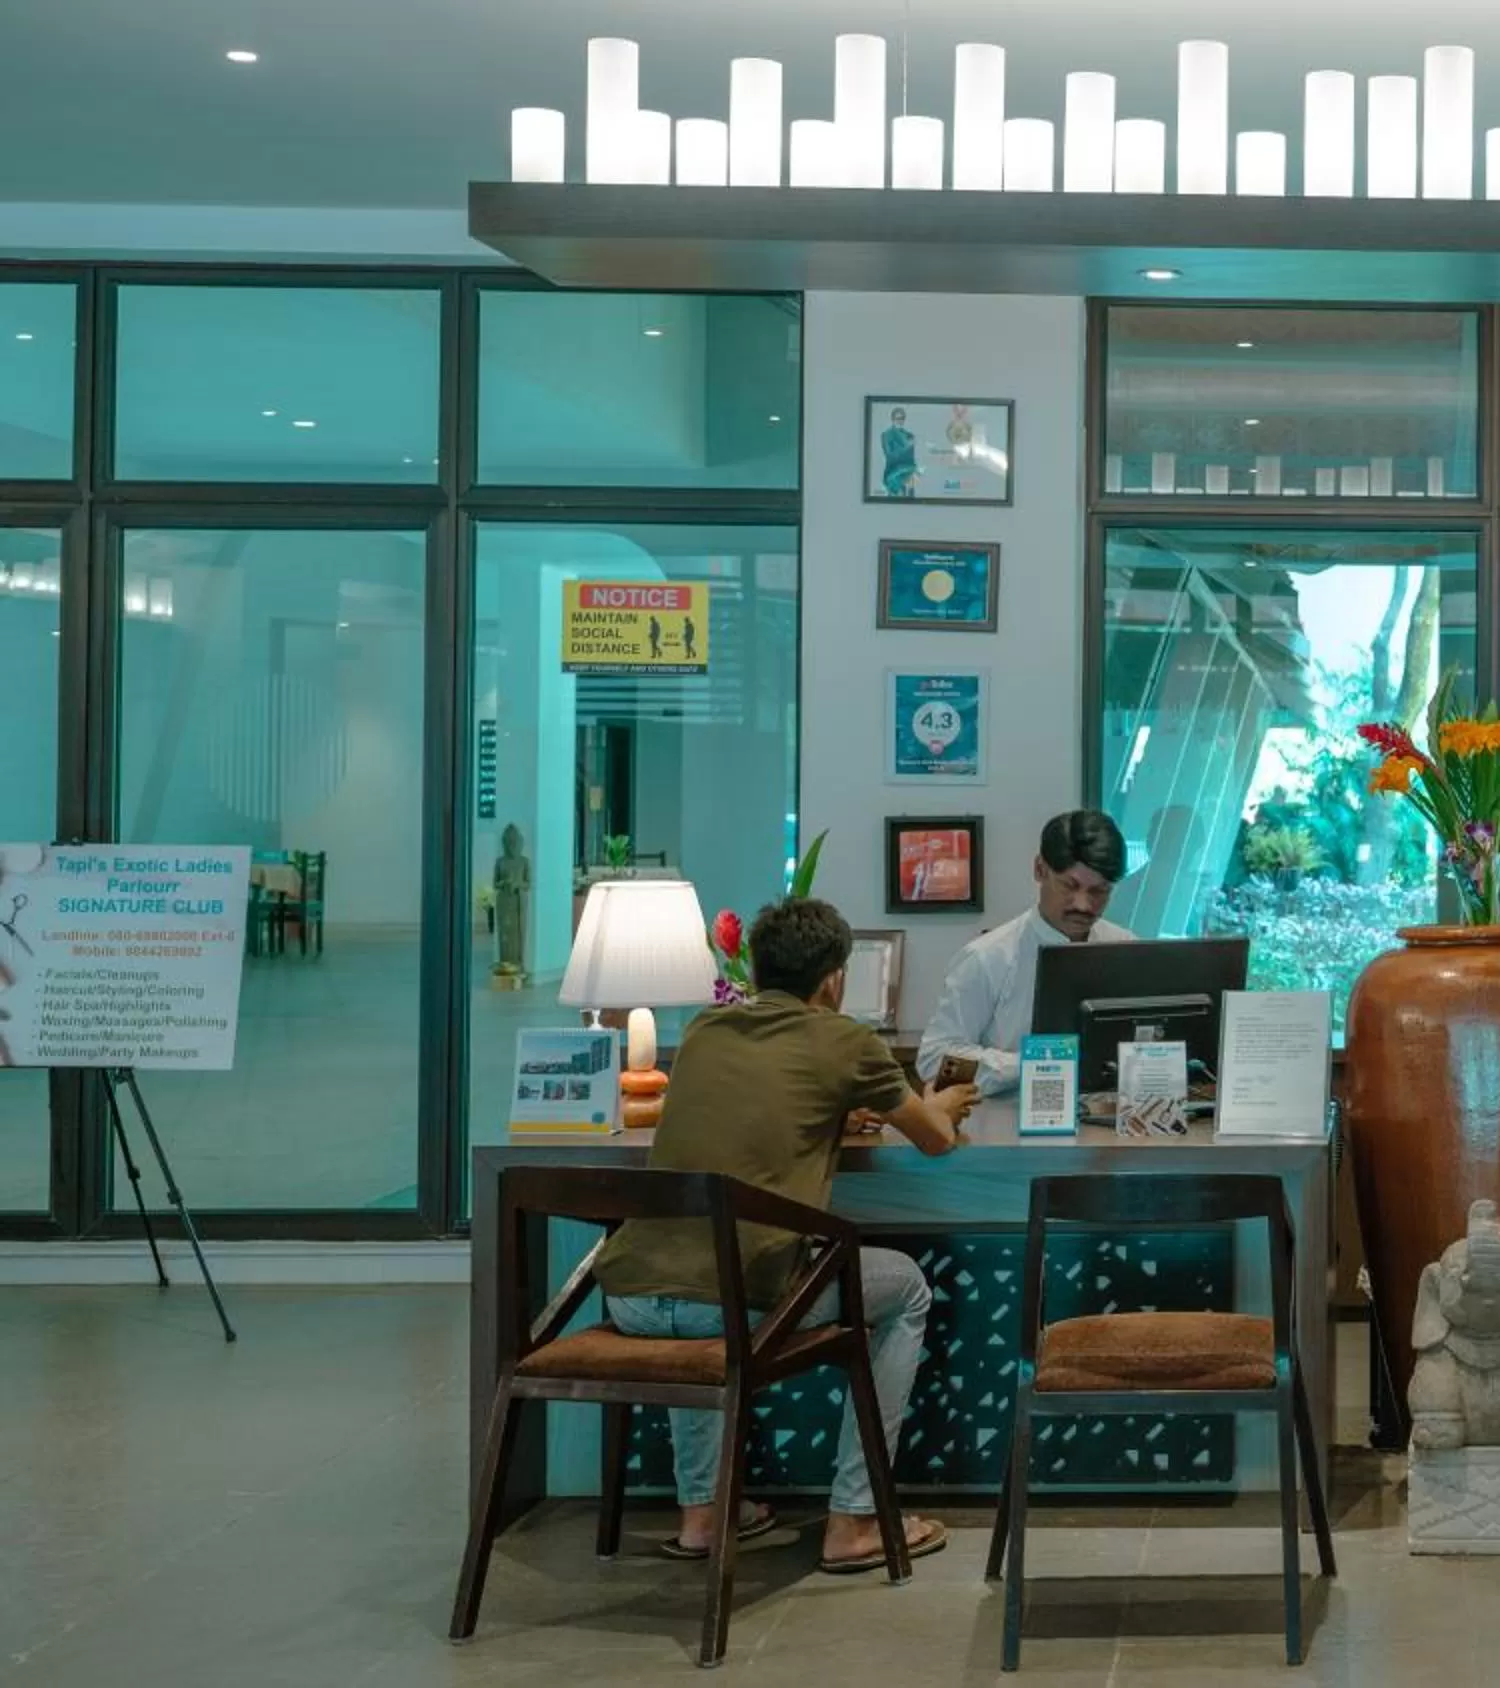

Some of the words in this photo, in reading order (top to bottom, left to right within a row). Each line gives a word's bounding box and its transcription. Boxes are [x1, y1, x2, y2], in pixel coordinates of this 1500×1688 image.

[592, 588, 680, 607] NOTICE
[571, 612, 639, 625] MAINTAIN
[571, 627, 624, 639] SOCIAL
[571, 643, 641, 655] DISTANCE
[920, 711, 953, 729] 4.3
[113, 857, 169, 873] Exotic
[175, 858, 233, 874] Ladies
[58, 899, 166, 914] SIGNATURE
[172, 899, 224, 914] CLUB
[43, 1000, 70, 1011] Hair
